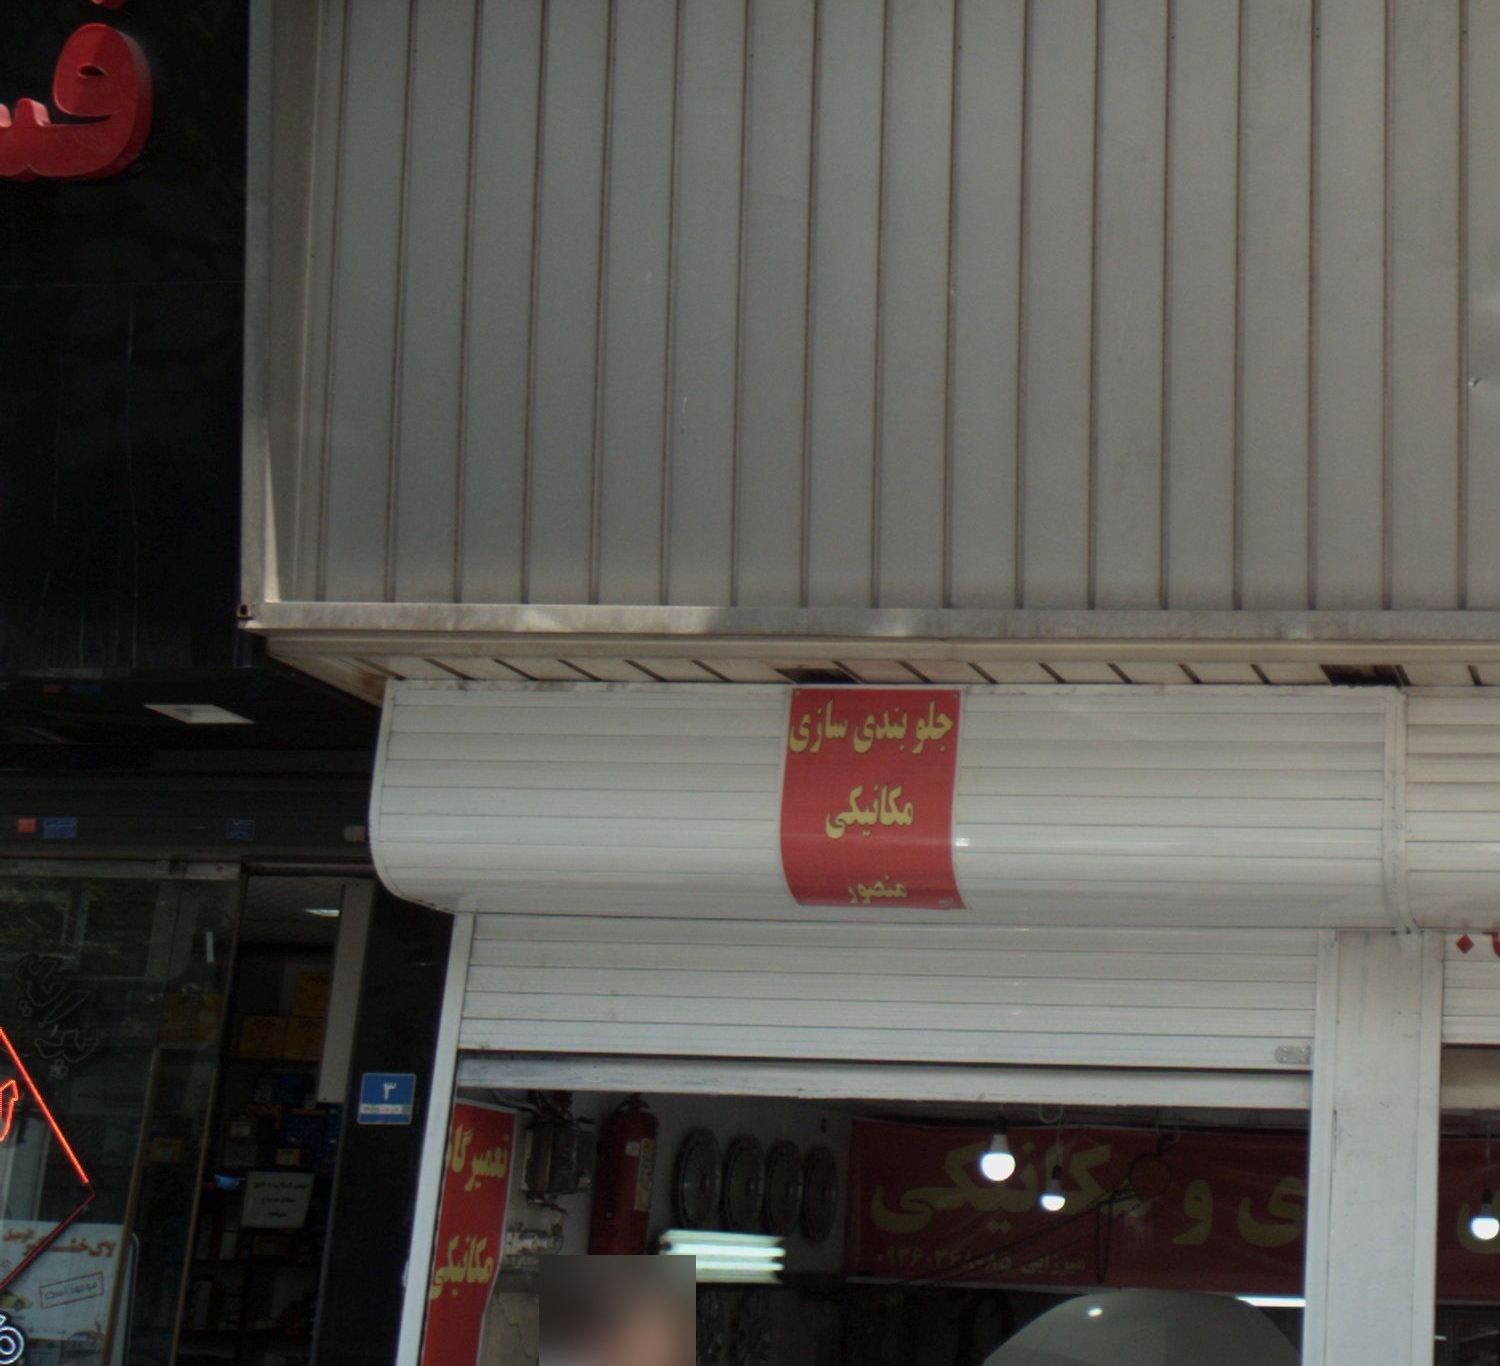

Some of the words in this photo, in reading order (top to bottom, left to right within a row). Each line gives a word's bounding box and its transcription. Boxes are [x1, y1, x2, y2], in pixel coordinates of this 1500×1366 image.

[788, 699, 848, 753] سازی
[853, 706, 907, 753] بندی
[912, 700, 953, 754] جلو
[825, 785, 914, 839] مکانیکی
[1172, 1179, 1215, 1245] و
[428, 1235, 495, 1300] مکانیکی
